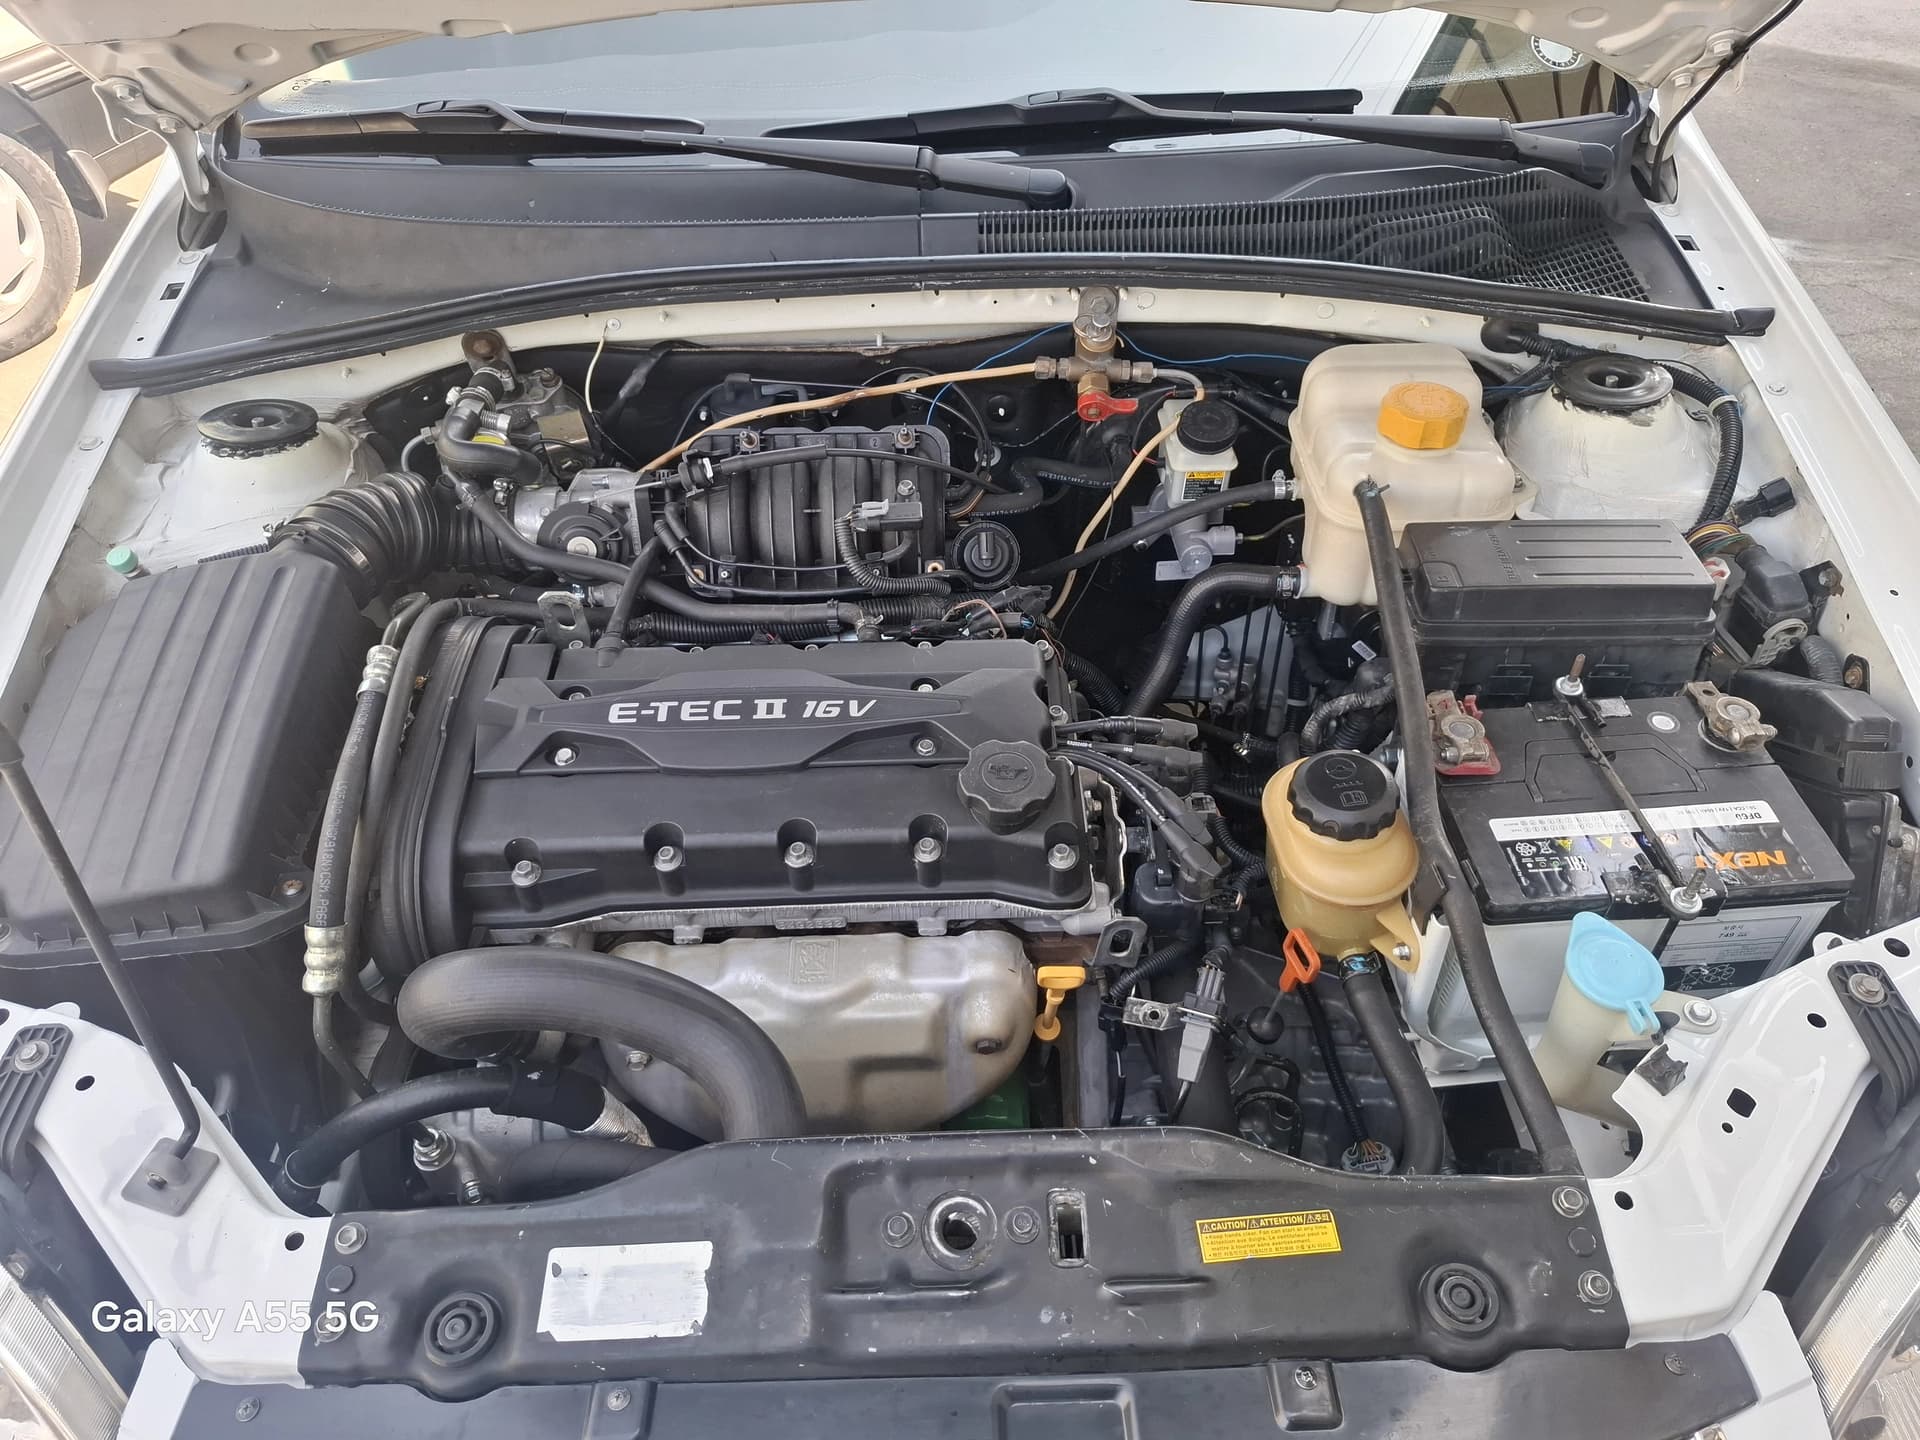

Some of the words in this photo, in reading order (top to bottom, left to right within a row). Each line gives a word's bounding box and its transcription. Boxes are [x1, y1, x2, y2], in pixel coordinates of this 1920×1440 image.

[608, 700, 743, 723] E-TEC
[1211, 1220, 1246, 1231] CAUTION
[1260, 1215, 1303, 1227] ATTENTION
